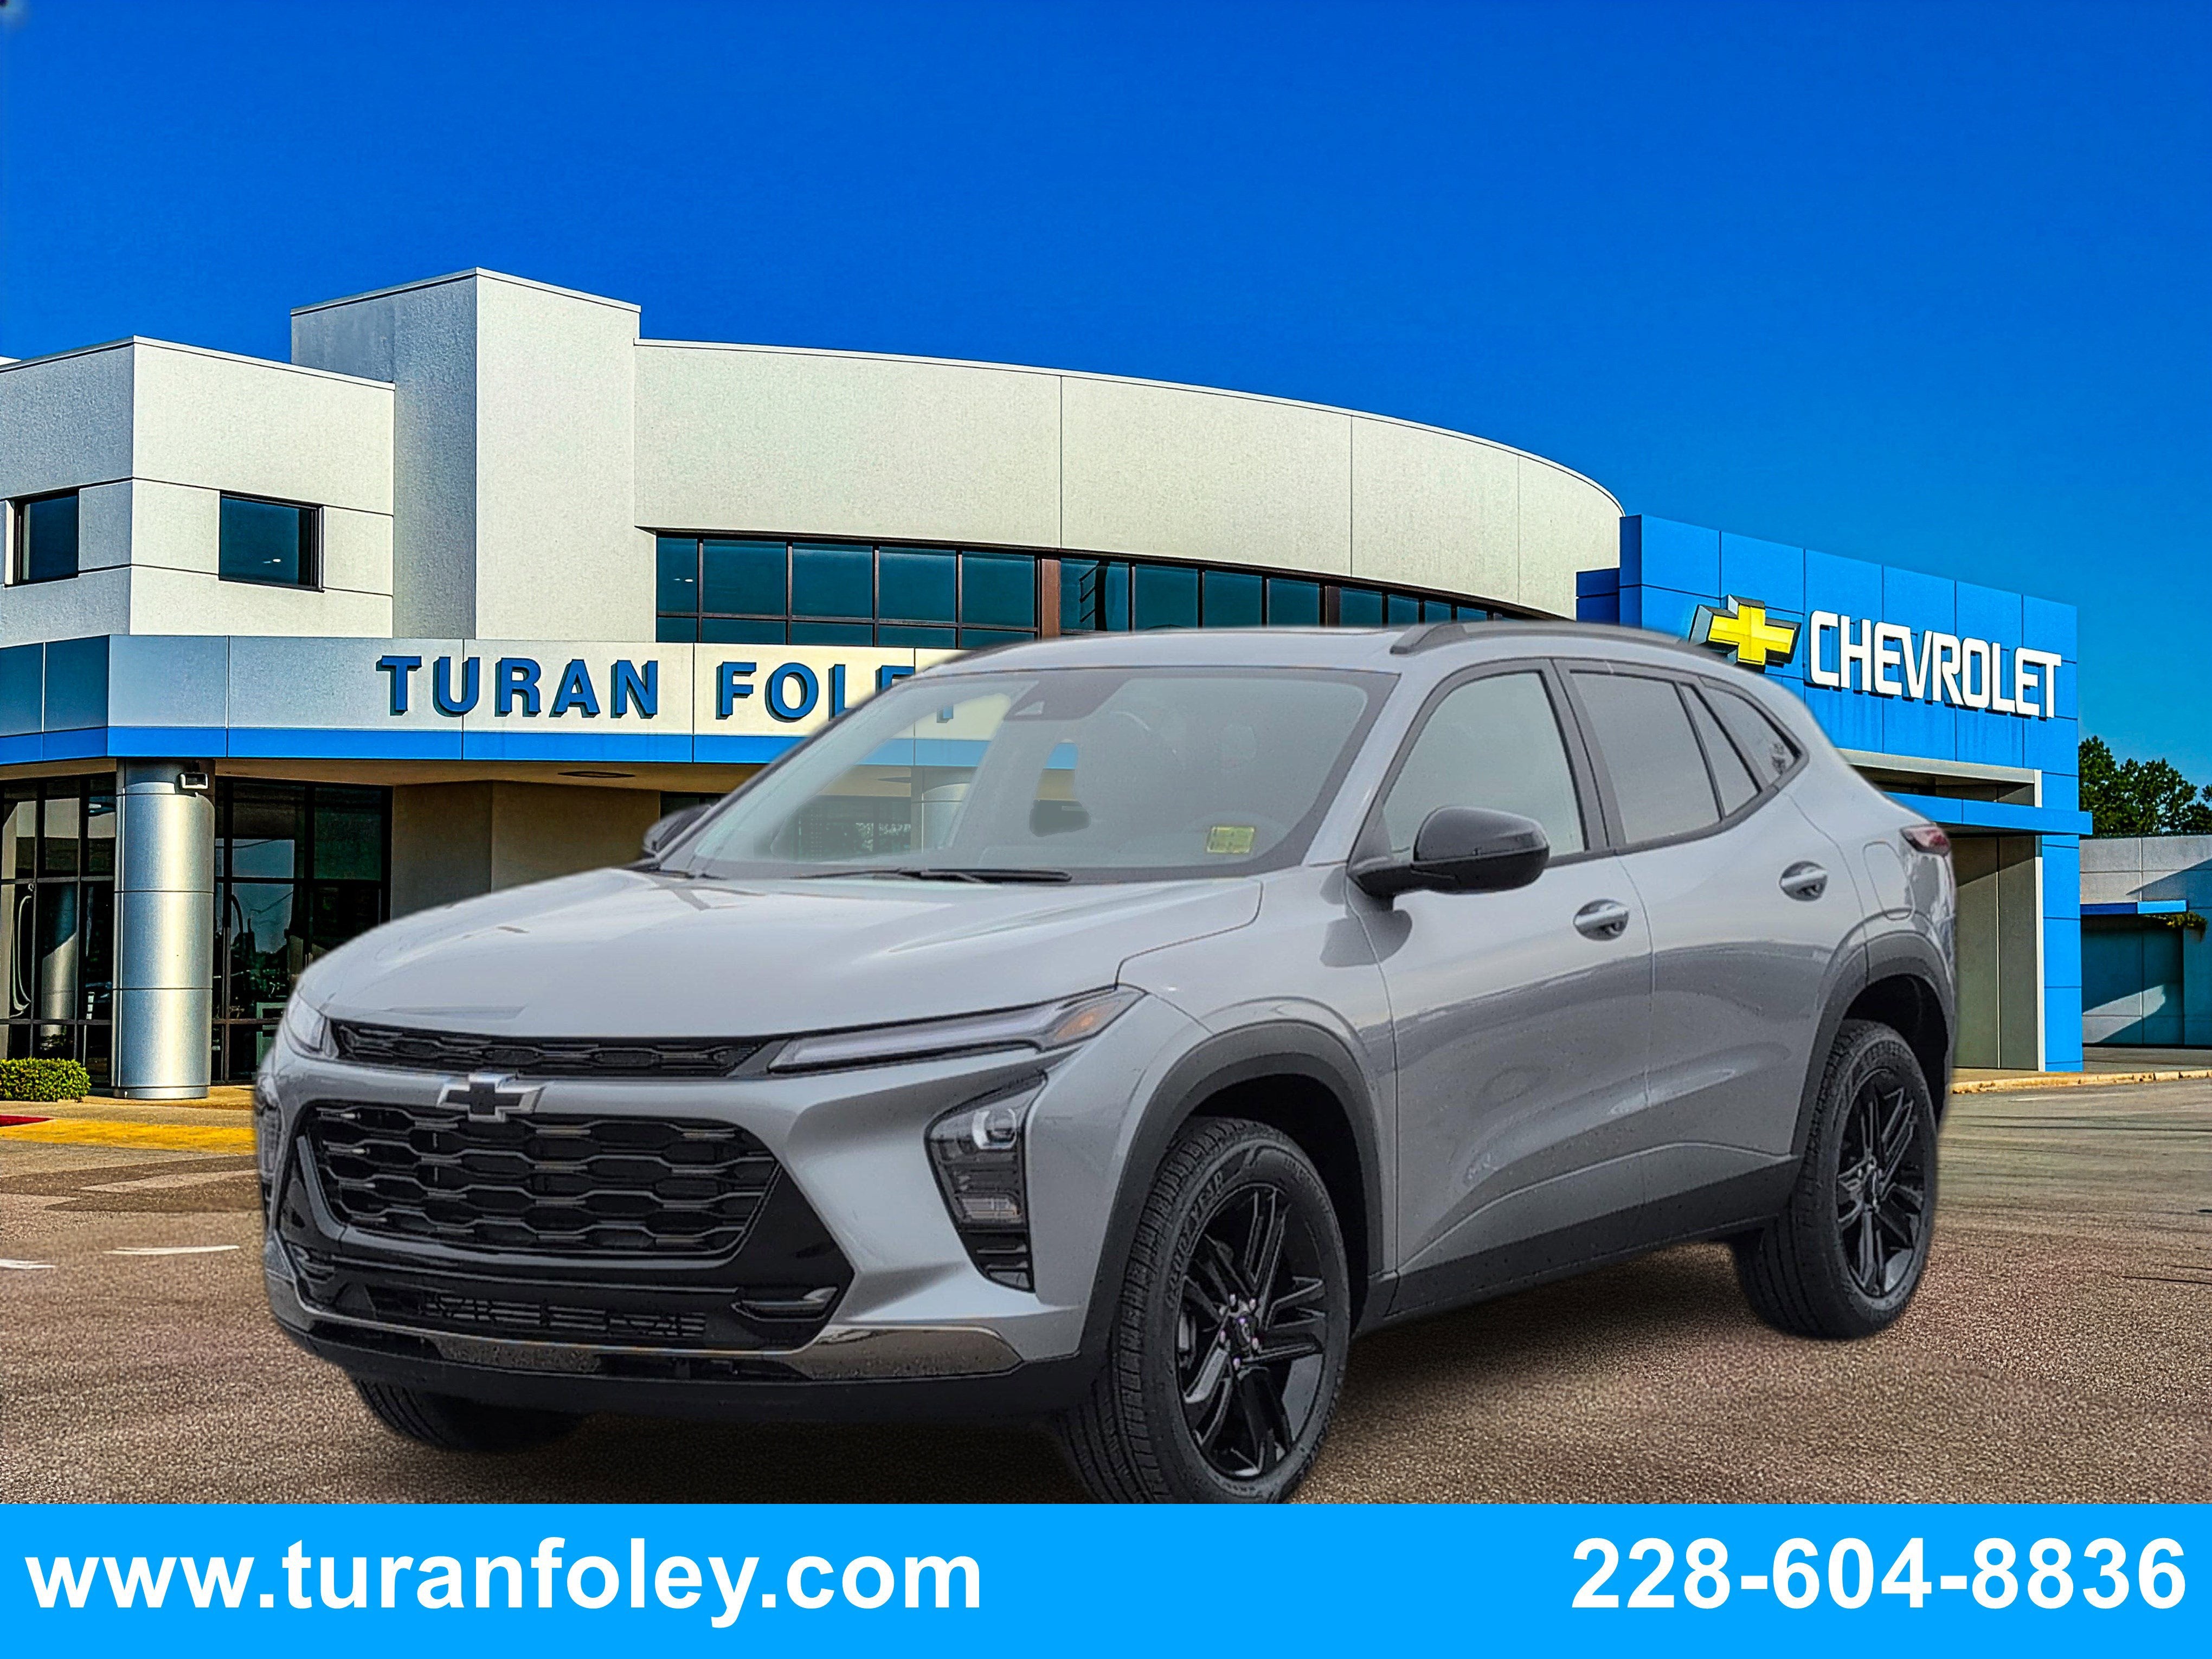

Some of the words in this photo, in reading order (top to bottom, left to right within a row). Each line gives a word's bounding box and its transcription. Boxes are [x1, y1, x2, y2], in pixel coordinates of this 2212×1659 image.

[376, 655, 658, 719] TURAN
[716, 661, 954, 723] FOL
[1810, 609, 2062, 720] CHEVROLET
